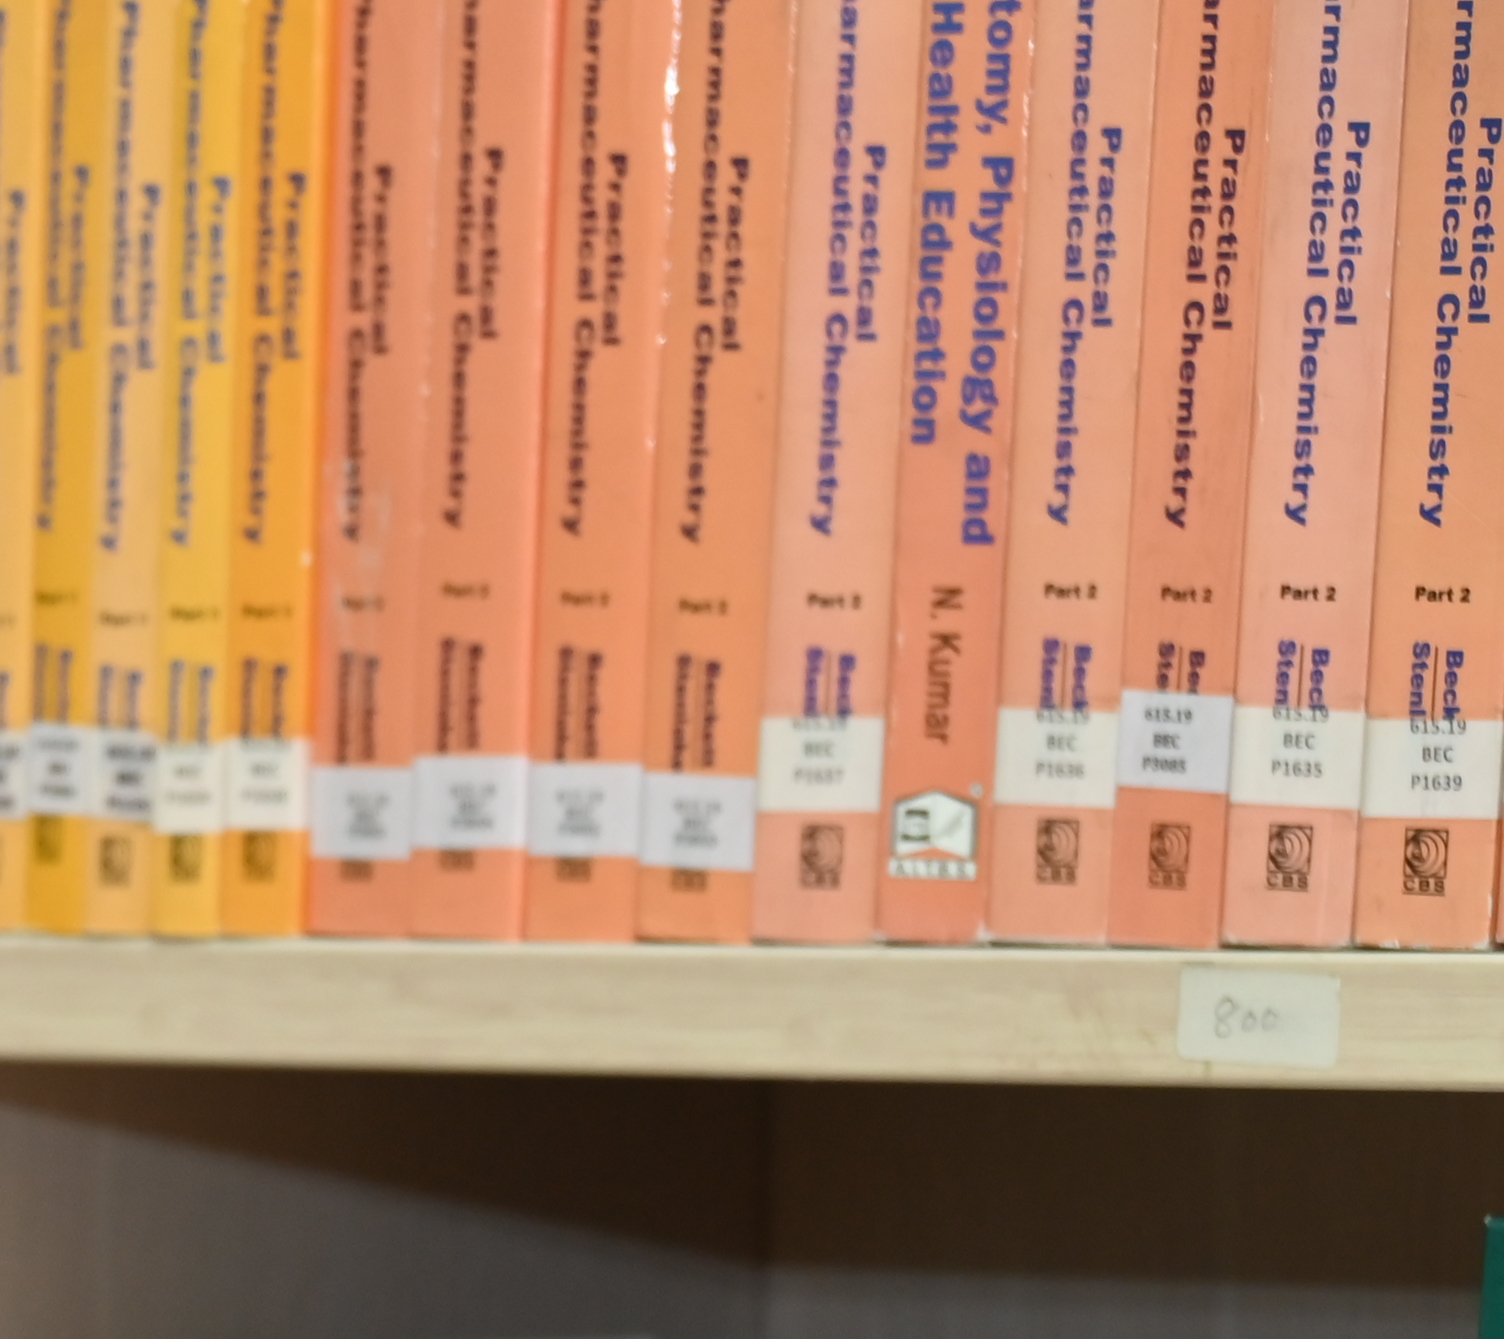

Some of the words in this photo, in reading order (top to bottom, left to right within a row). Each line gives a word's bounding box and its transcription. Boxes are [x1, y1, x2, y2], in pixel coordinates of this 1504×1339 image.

[828, 0, 859, 298] armaceutical
[925, 2, 966, 170] Health
[1307, 0, 1344, 278] rmaceutical
[720, 155, 751, 352] Practical
[856, 145, 887, 342] Practical
[911, 190, 956, 445] Education
[959, 157, 1014, 434] Physiology
[1092, 128, 1123, 328] Practical
[1212, 128, 1246, 331] Practical
[1335, 121, 1371, 326] Practical
[1468, 117, 1502, 324] Practical
[680, 323, 716, 544] Chemistry
[809, 314, 849, 536] Chemistry
[962, 453, 996, 546] and
[1047, 299, 1085, 526] Chemistry
[1165, 300, 1207, 530] Chemistry
[1285, 294, 1330, 526] Chemistry
[1419, 293, 1463, 528] Chemistry
[925, 632, 962, 744] Kumar
[931, 586, 963, 619] N.
[1415, 586, 1456, 603] Part
[1459, 587, 1472, 603] 2
[1271, 761, 1322, 778] P1635
[1283, 735, 1316, 751] BEC
[1410, 720, 1467, 736] 615.19
[1411, 776, 1463, 792] P1639
[1422, 747, 1454, 763] BEC
[1266, 874, 1310, 890] CBS
[1403, 878, 1445, 893] CBS
